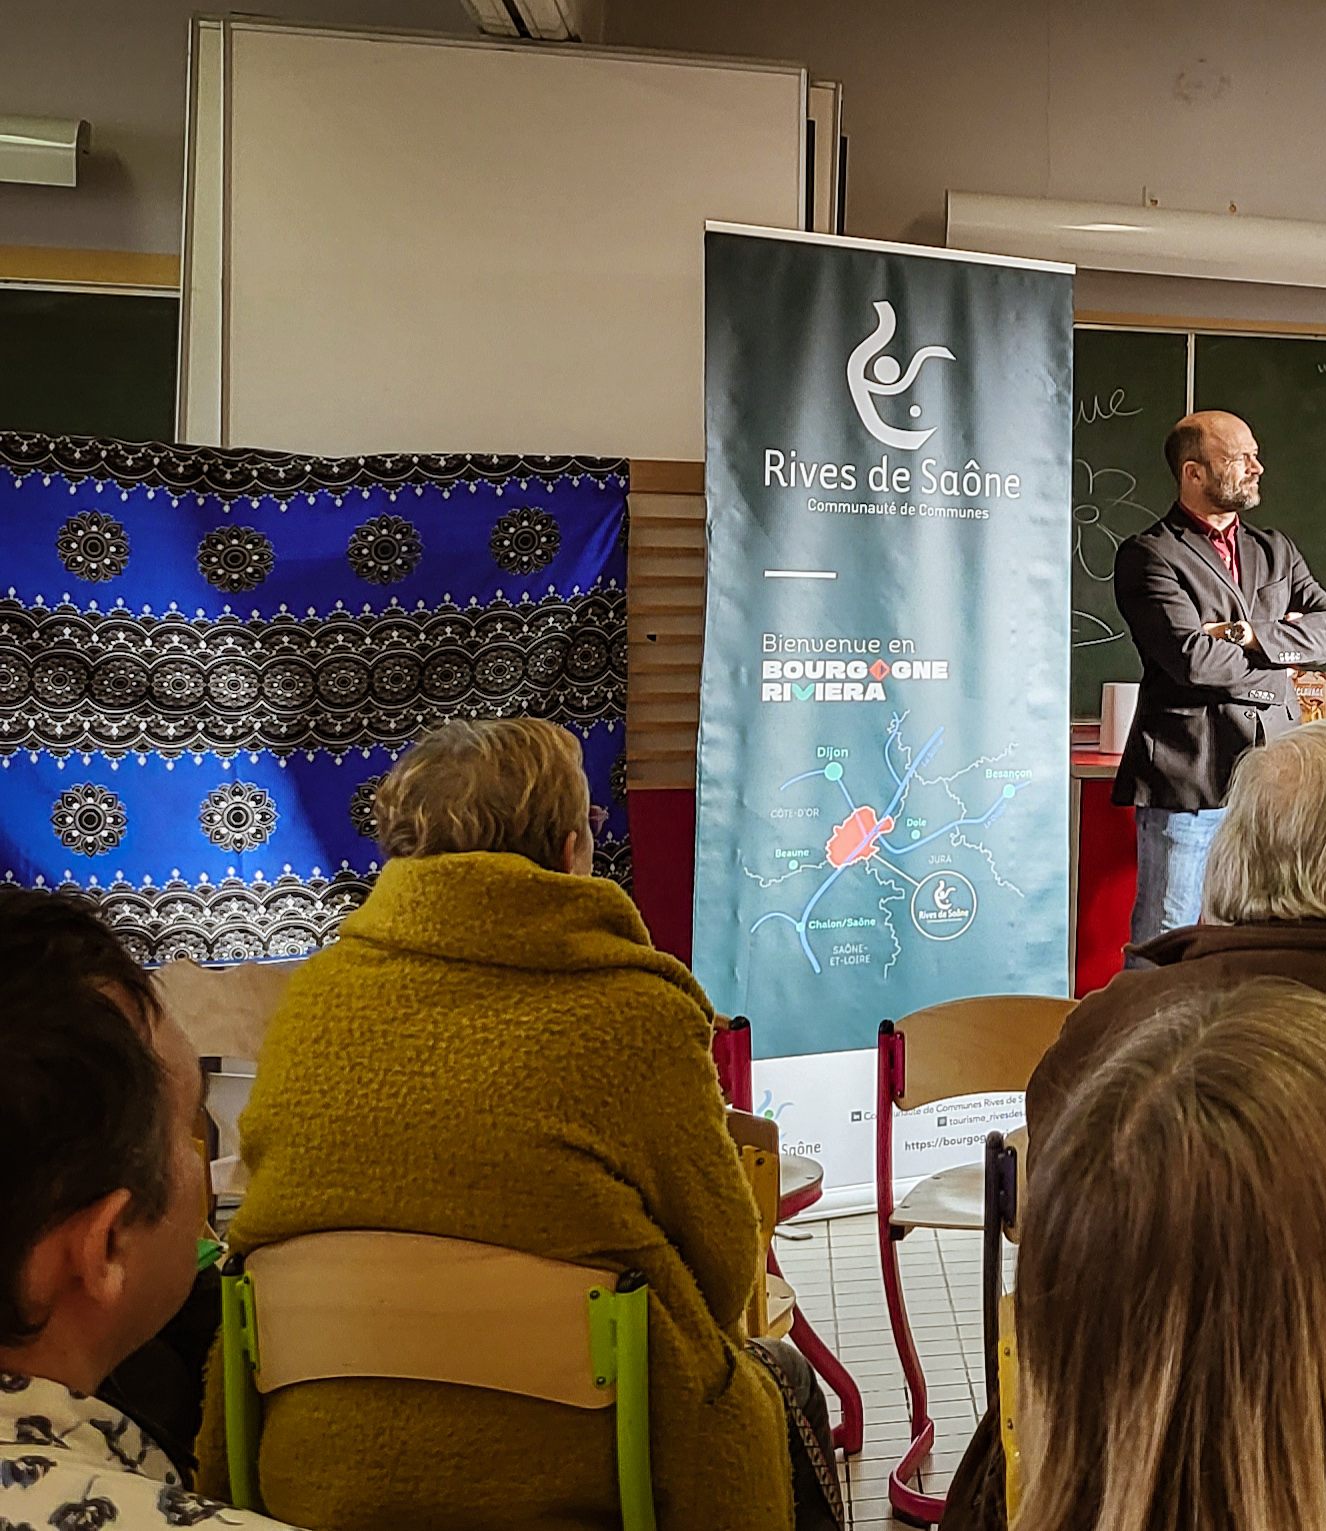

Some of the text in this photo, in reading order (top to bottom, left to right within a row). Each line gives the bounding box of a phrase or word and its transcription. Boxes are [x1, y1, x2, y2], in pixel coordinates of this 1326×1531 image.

[763, 448, 1021, 499] Rives de Saône
[807, 498, 989, 520] Communauté de Communes
[762, 632, 915, 655] Bienvenue en
[762, 682, 887, 702] RIVIERA
[817, 746, 848, 760] Dijon
[985, 768, 1033, 780] Besançon
[770, 807, 819, 818] CÔTE-D'OR
[906, 817, 927, 827] Dole
[774, 848, 809, 858] Beaune
[928, 854, 952, 864] JURA
[918, 910, 937, 920] Rives
[808, 917, 876, 930] Chalon/Saône
[832, 943, 867, 954] SAÔNE-
[829, 954, 871, 966] ET-LOIRE
[936, 1101, 981, 1113] Communes
[983, 1097, 1004, 1106] Rives
[949, 1108, 1022, 1125] tourisme_rivesdes
[781, 1140, 821, 1155] Saône
